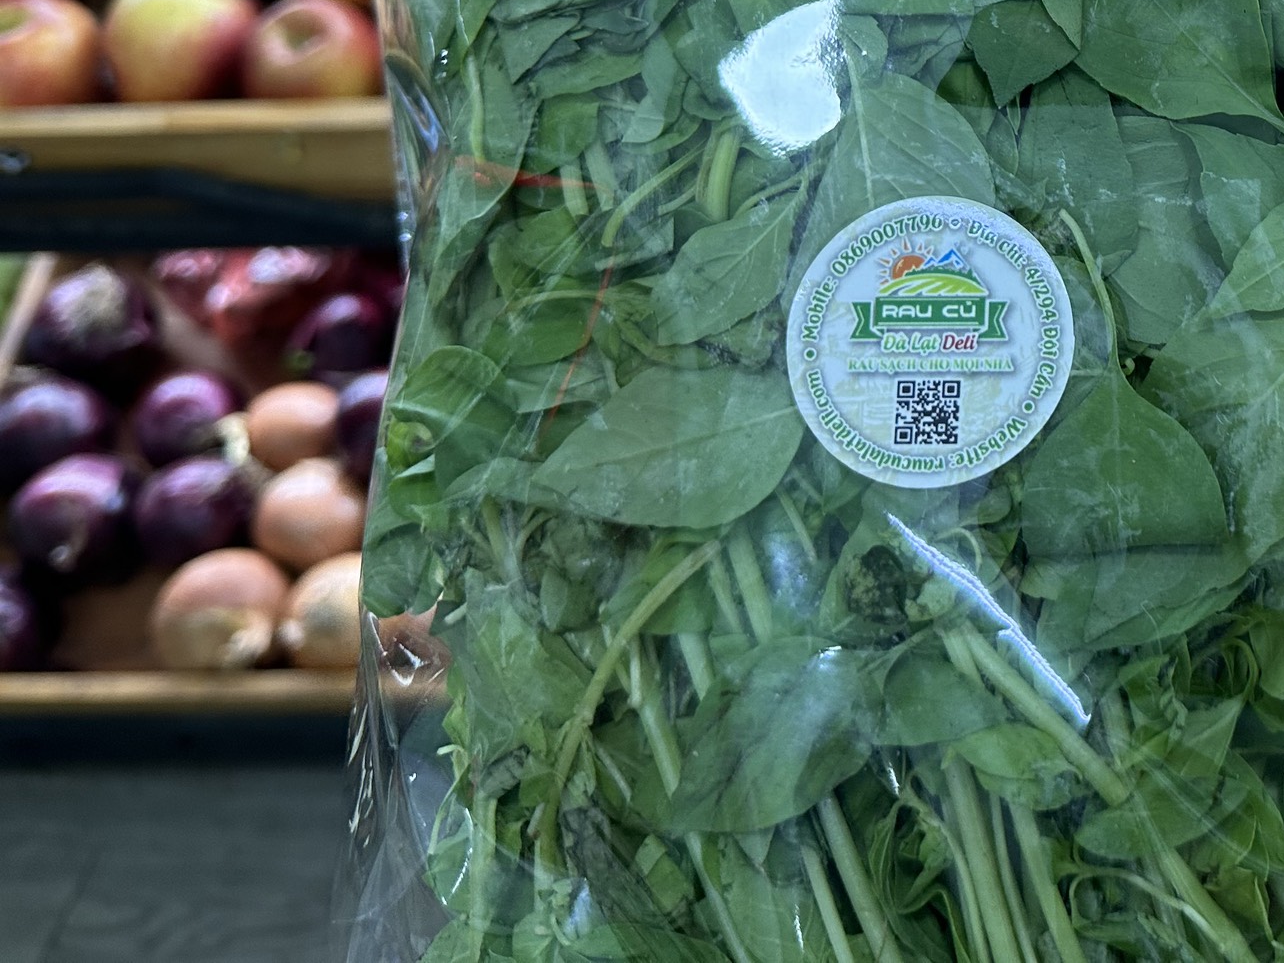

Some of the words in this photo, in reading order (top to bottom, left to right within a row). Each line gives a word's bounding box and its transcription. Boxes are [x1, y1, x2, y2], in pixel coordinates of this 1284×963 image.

[832, 214, 942, 278] 0869007796
[1027, 268, 1058, 321] 4/294
[882, 305, 932, 318] RAU
[942, 302, 977, 318] CỦ
[883, 334, 907, 351] Đà
[909, 334, 940, 355] Lạt
[942, 334, 977, 350] Deli
[848, 359, 877, 370] RAU
[879, 359, 916, 374] SẠCH
[920, 359, 949, 370] CHO
[953, 359, 980, 373] MỌI
[983, 356, 1013, 370] NHÀ
